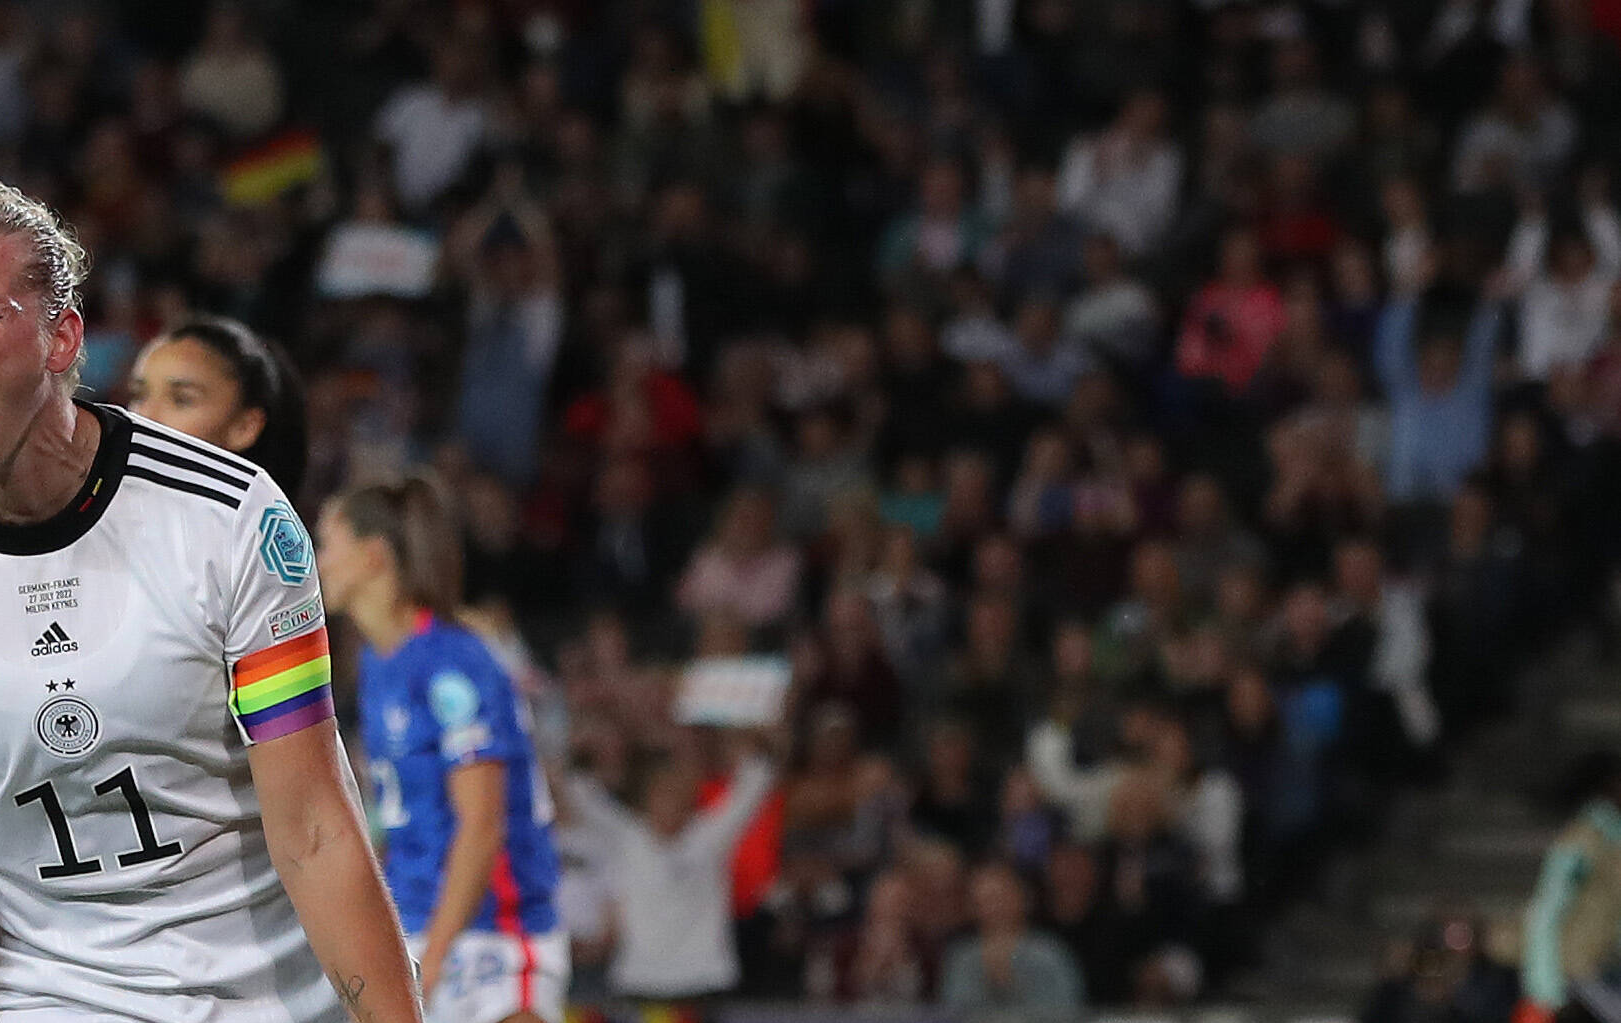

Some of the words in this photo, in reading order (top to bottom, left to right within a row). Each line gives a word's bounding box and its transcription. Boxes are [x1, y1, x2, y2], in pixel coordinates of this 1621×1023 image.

[18, 577, 80, 595] GERMANY-FRANCE
[29, 594, 37, 604] 27
[40, 592, 54, 602] JULY
[56, 589, 72, 600] 2022
[25, 602, 50, 614] MILTON
[51, 598, 78, 611] KEYNES
[31, 641, 79, 657] adidas
[14, 765, 184, 880] 11
